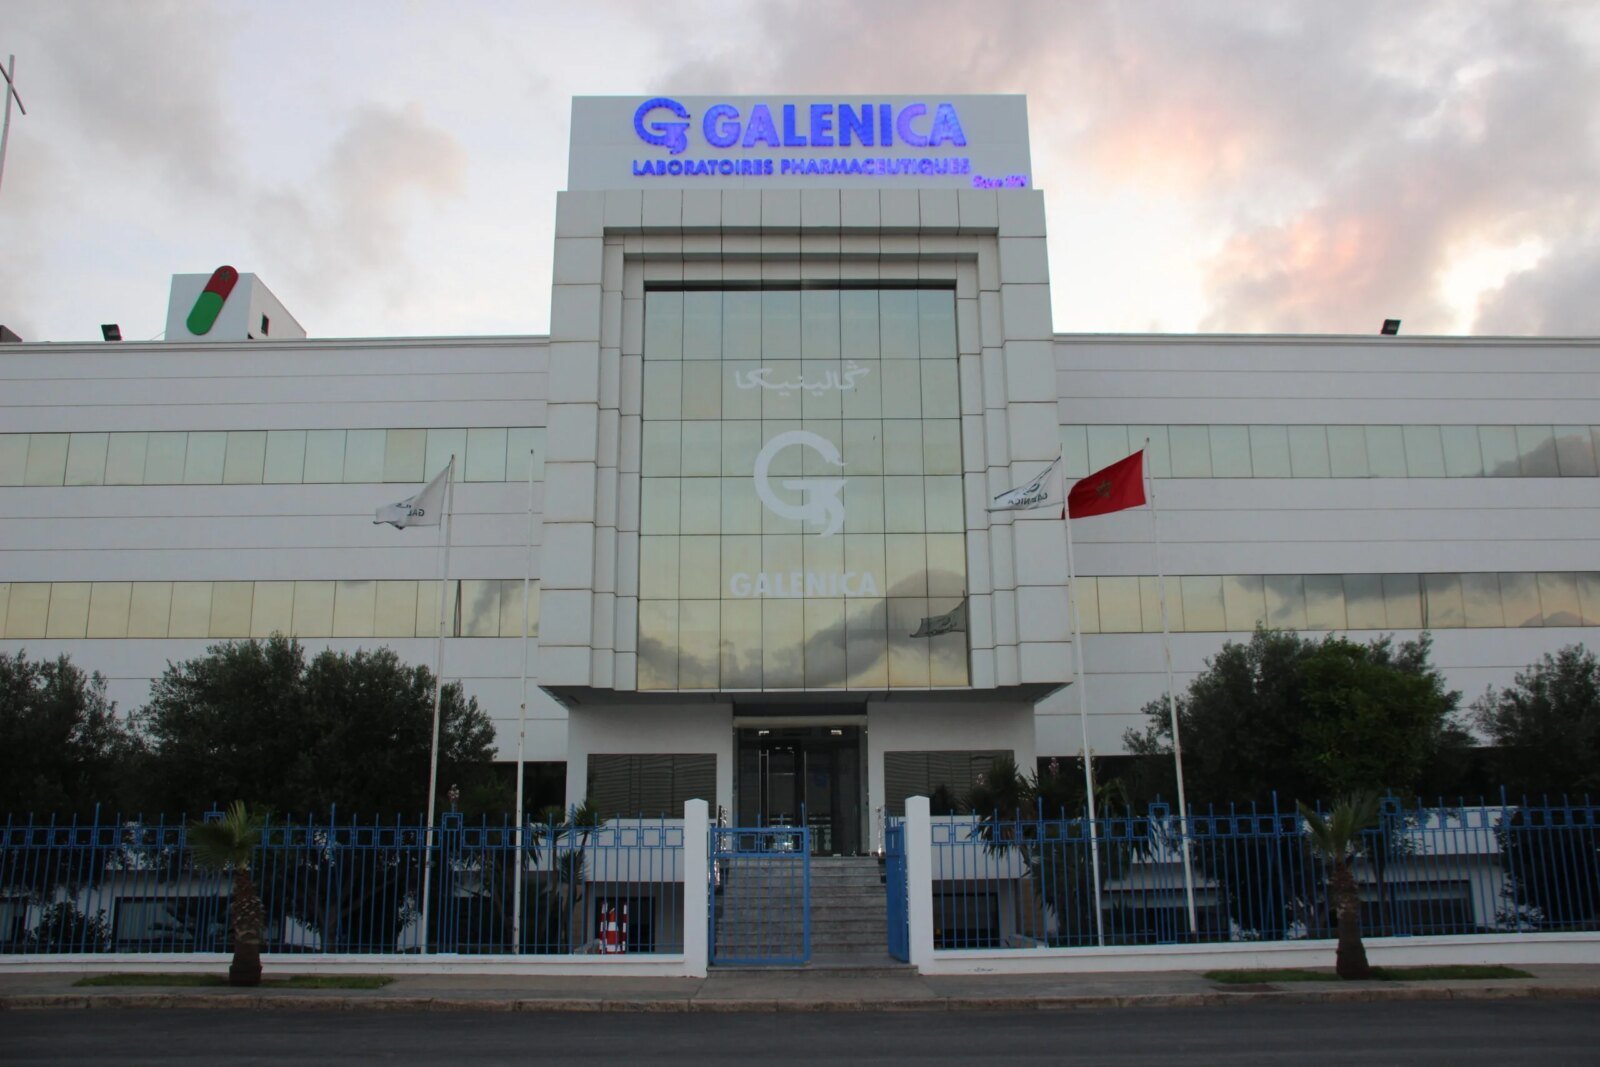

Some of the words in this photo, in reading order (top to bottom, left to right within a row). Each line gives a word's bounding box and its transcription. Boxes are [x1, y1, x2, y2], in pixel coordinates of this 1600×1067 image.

[702, 103, 967, 148] GALENICA
[632, 159, 775, 176] LABORATOIRES
[780, 158, 971, 175] PHARMACEUTIQUES
[729, 570, 879, 597] GALENICA
